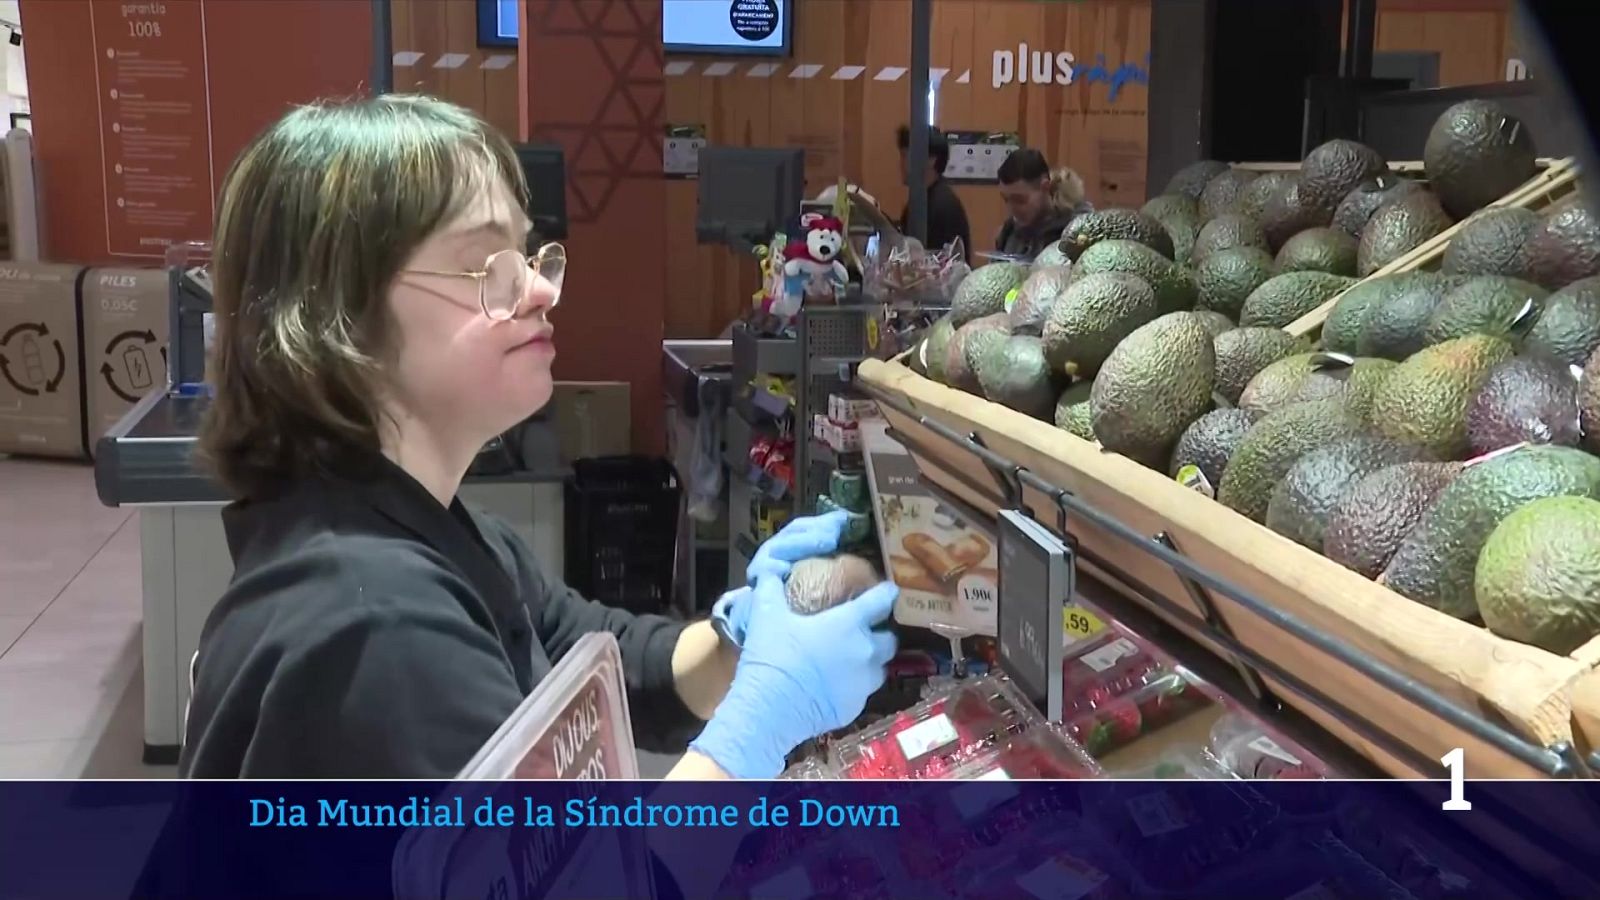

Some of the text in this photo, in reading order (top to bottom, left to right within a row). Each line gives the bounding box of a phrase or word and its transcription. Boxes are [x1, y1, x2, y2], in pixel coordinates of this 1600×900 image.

[128, 21, 162, 37] 100%
[992, 42, 1075, 88] plus
[100, 275, 136, 287] PILES
[552, 688, 600, 778] DIJOUS
